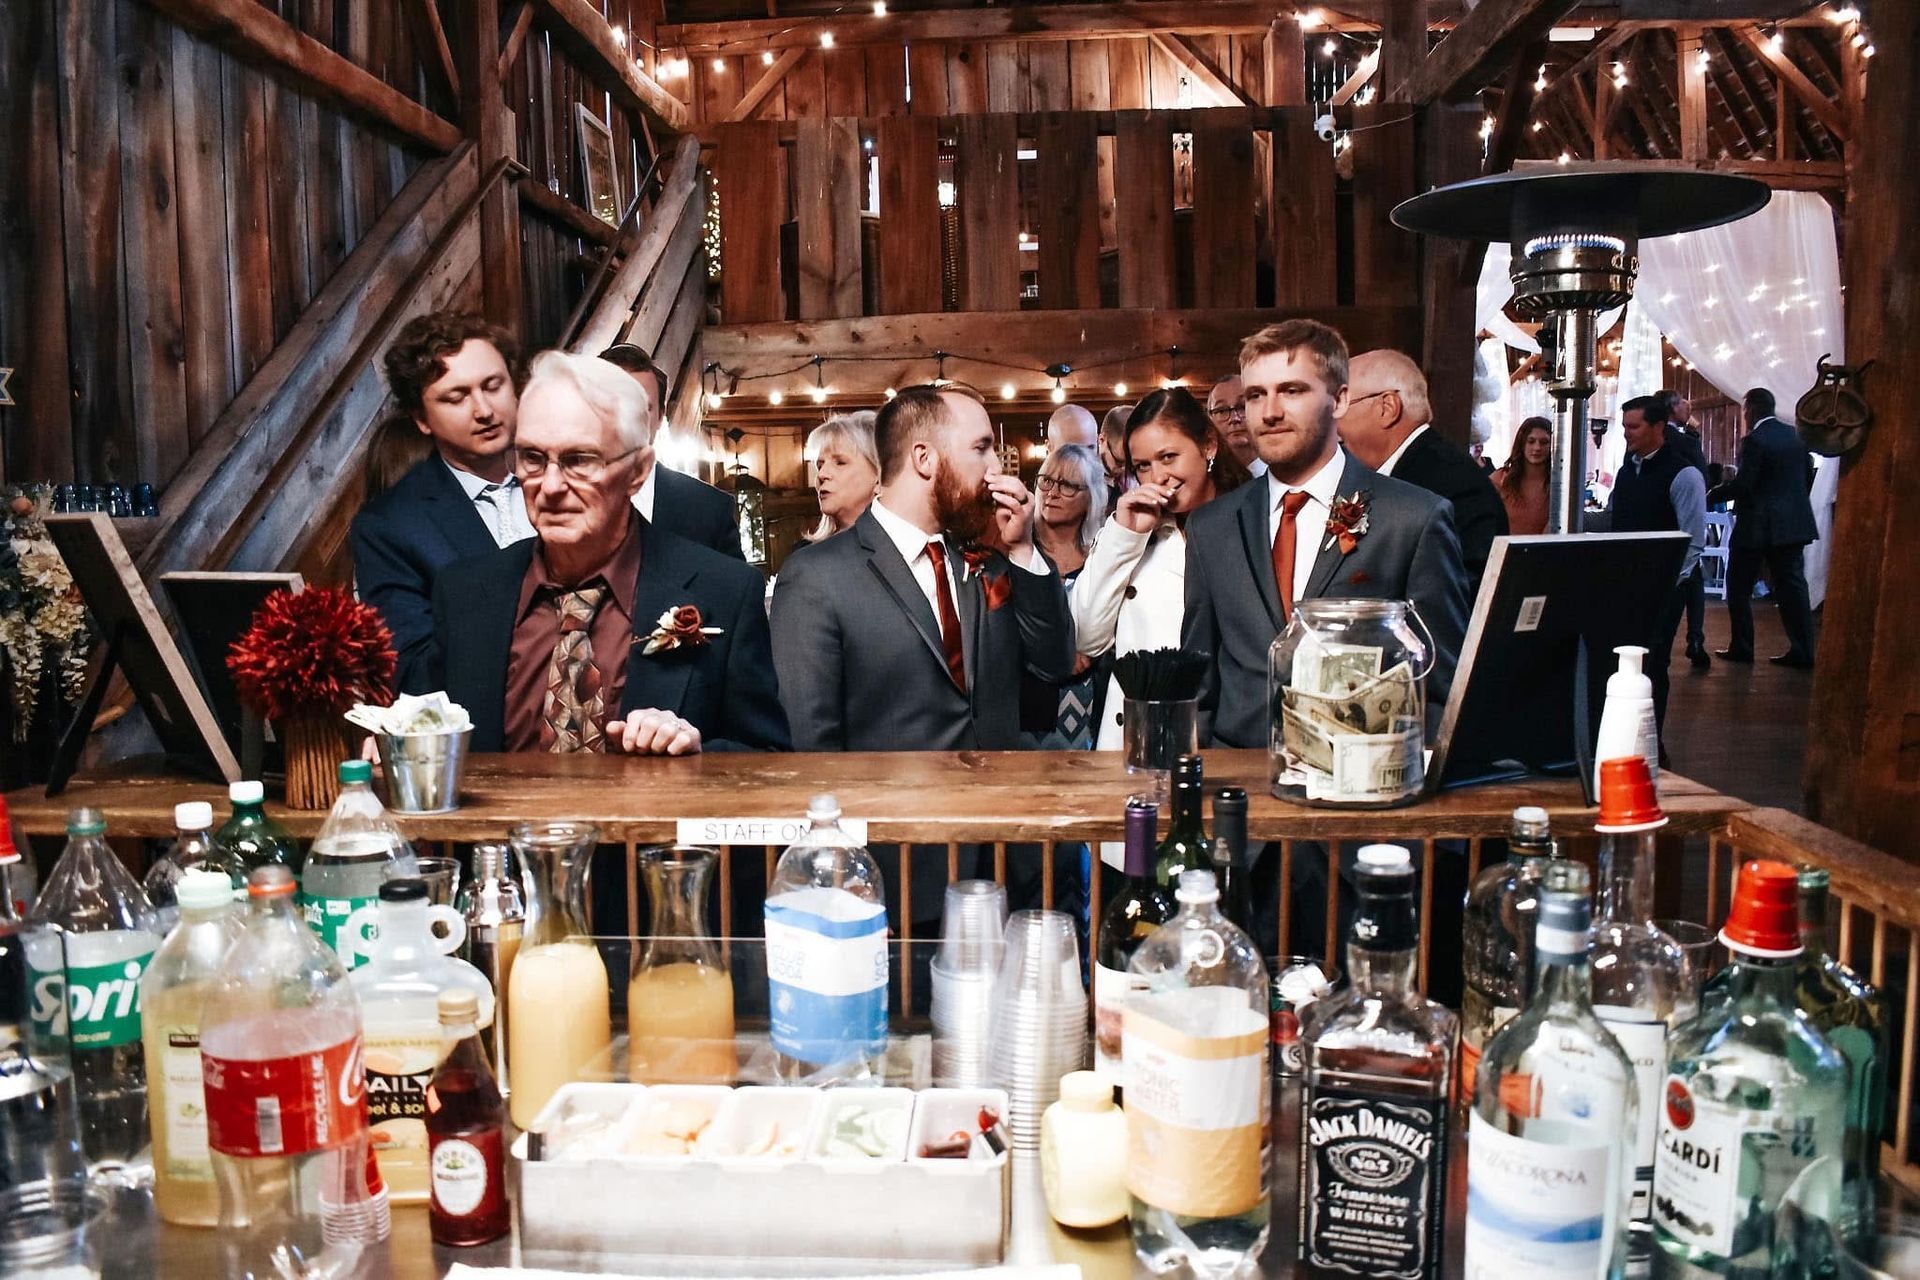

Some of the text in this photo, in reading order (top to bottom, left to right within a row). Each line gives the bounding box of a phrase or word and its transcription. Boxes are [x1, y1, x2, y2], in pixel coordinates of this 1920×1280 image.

[704, 823, 773, 841] STAFF
[31, 961, 140, 1036] Spri
[365, 1075, 434, 1096] AILY
[1309, 1108, 1434, 1160] JACK DANIEL'S
[1663, 1129, 1722, 1174] CARDÍ
[1329, 1206, 1408, 1228] WHISKEY
